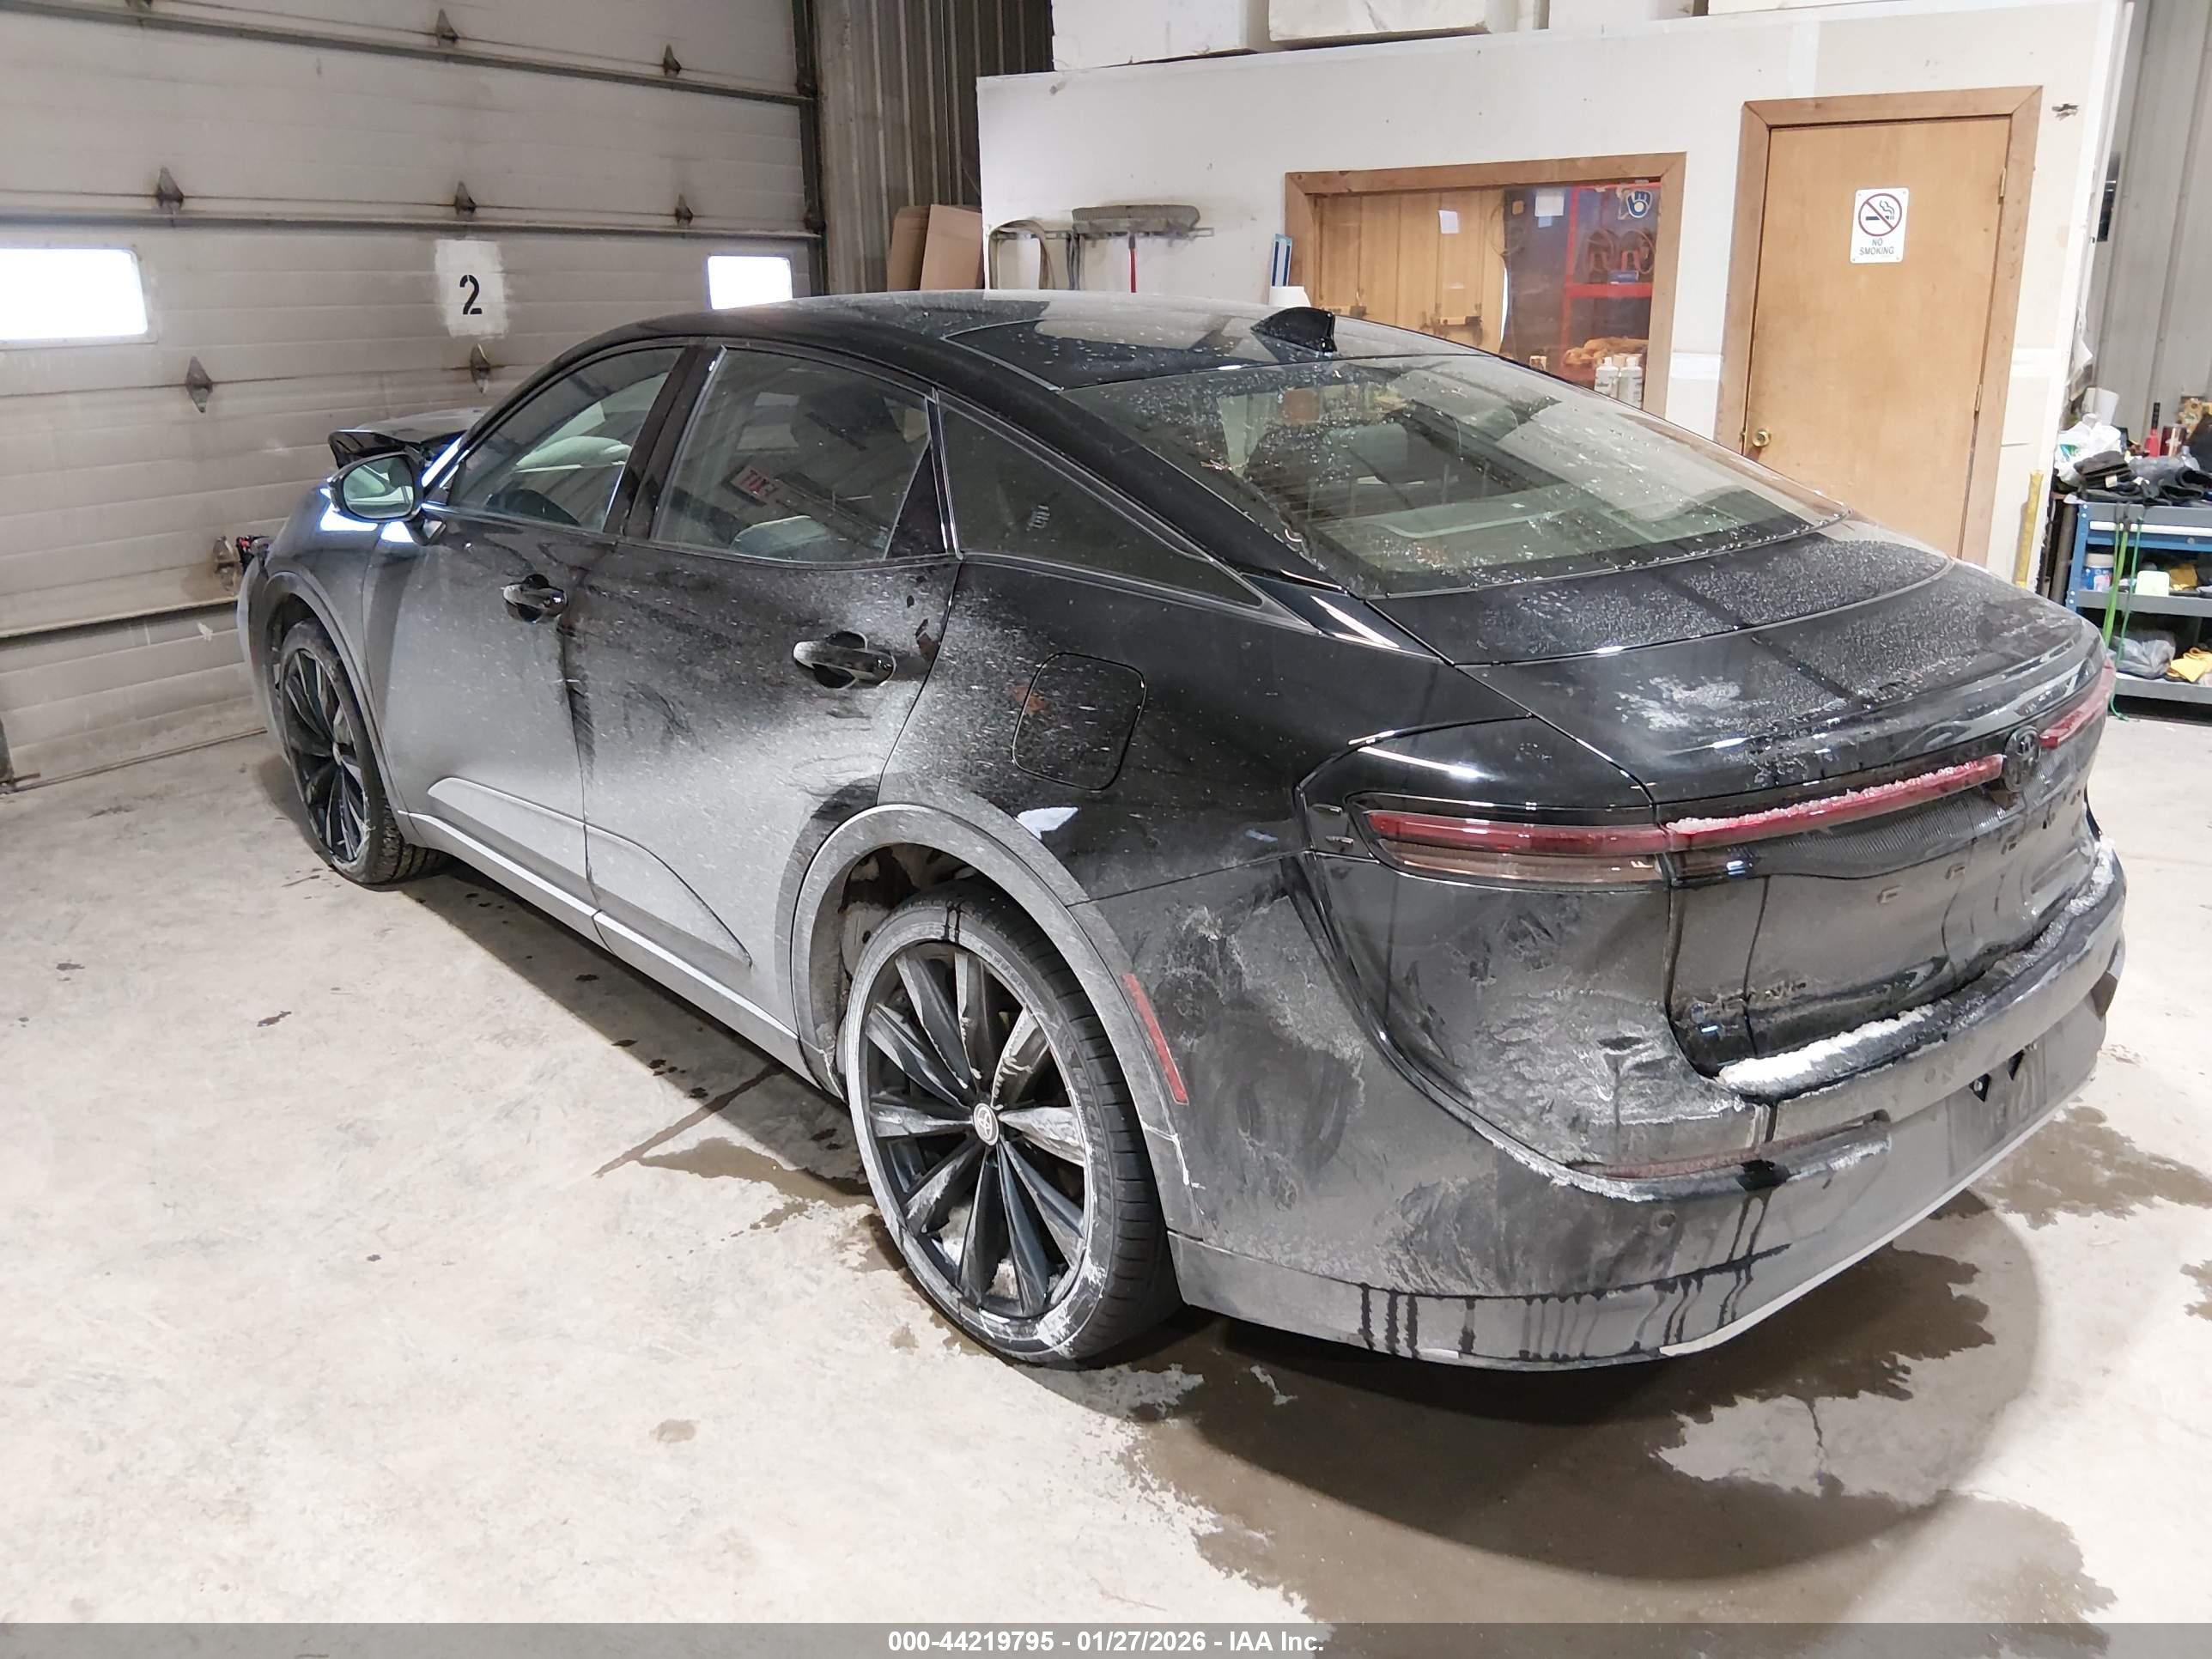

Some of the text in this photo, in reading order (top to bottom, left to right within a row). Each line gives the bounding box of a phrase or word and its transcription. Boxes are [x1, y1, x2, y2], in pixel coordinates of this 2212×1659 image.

[1872, 238, 1883, 246] NO
[1859, 246, 1894, 256] SMOKING
[459, 274, 483, 315] 2
